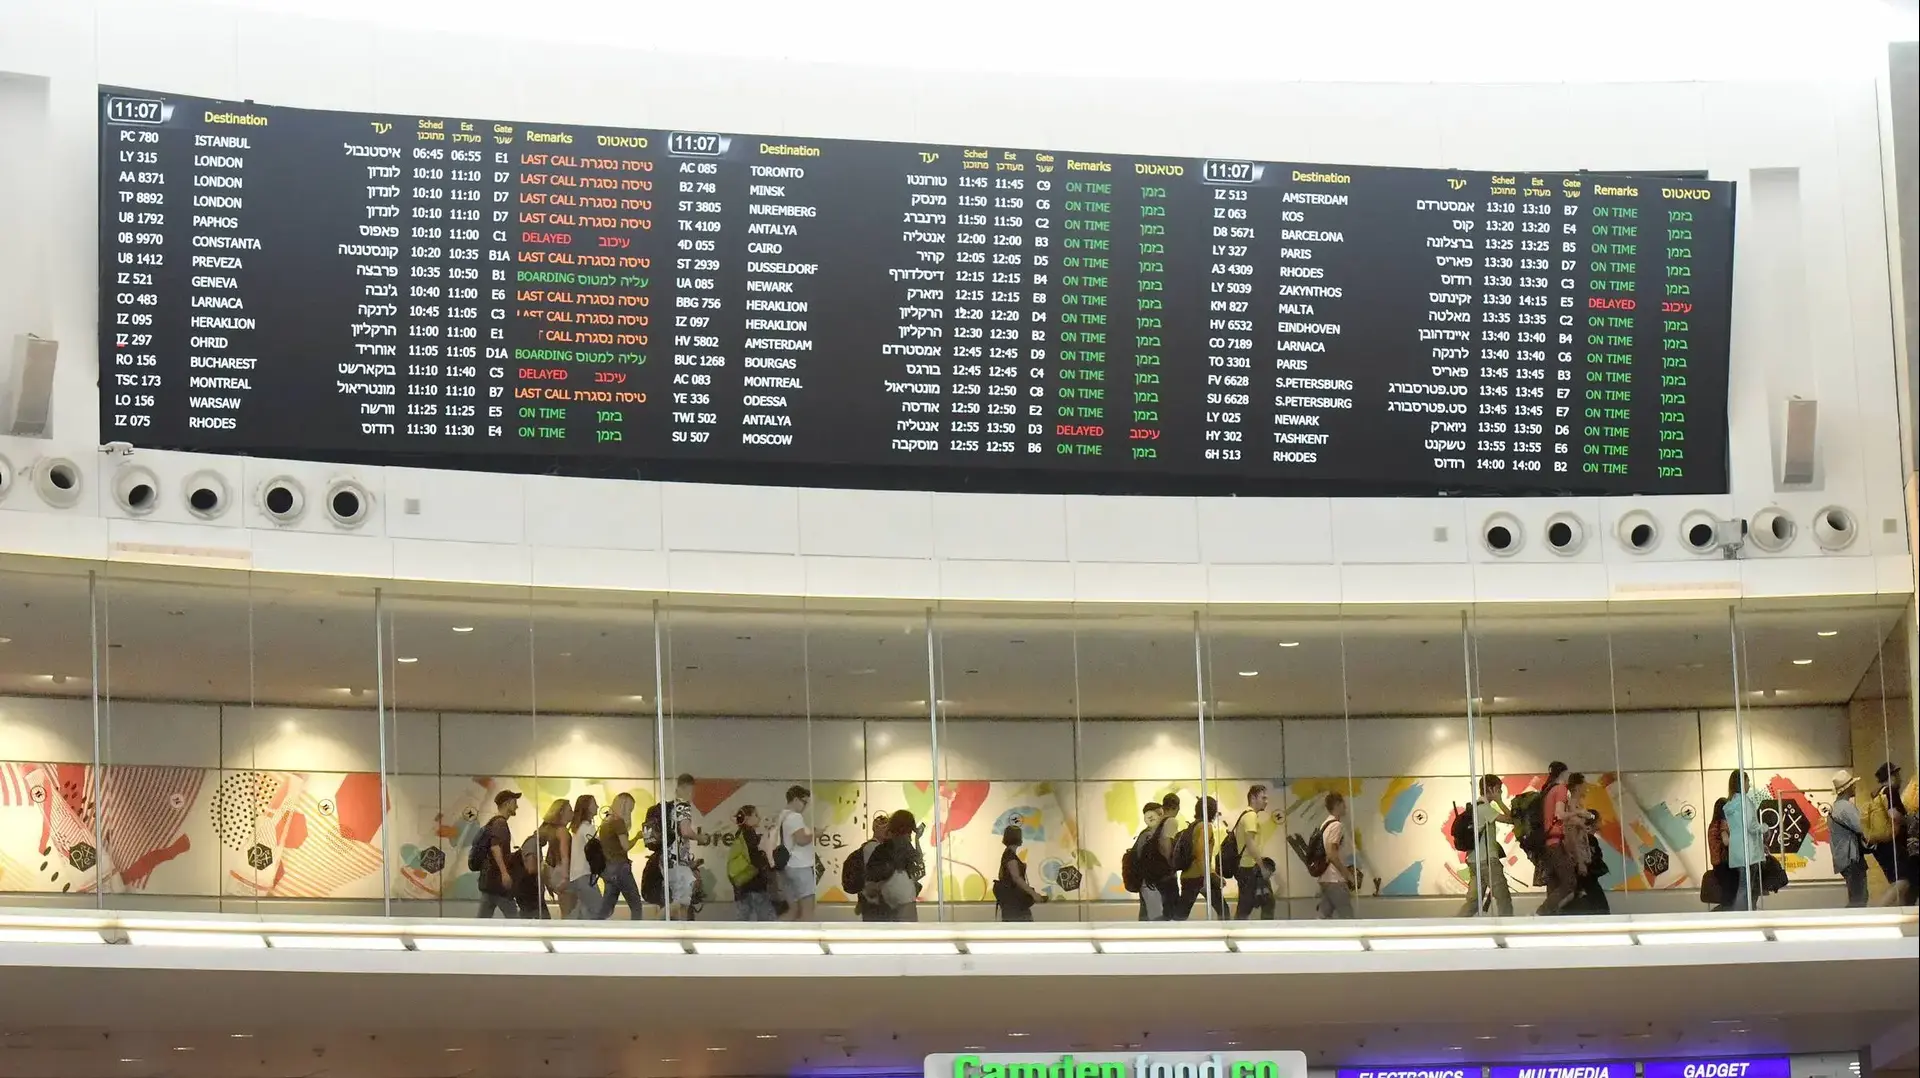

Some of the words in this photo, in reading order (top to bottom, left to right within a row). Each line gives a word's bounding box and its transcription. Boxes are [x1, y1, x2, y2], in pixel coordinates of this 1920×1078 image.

[115, 101, 158, 119] 11:07
[205, 111, 267, 126] Destination
[419, 120, 443, 129] Sched
[371, 122, 392, 134] יעד
[461, 123, 473, 131] Est
[494, 125, 512, 133] Gate
[120, 130, 136, 142] PC
[138, 131, 159, 143] 780
[195, 135, 251, 149] ISTANBUL
[494, 136, 512, 144] שער
[527, 131, 573, 143] Remarks
[597, 135, 647, 148] סטאטוס
[676, 136, 715, 150] 11:07
[344, 142, 401, 158] איסטנבול
[413, 148, 443, 160] 06:45
[760, 143, 820, 156] Destination
[964, 150, 987, 158] Sched
[194, 155, 243, 168] LONDON
[451, 150, 481, 162] 06:55
[495, 152, 508, 163] E1
[521, 154, 548, 165] LAST
[551, 156, 577, 166] CALL
[918, 152, 939, 163] יעד
[1004, 152, 1016, 160] Est
[1036, 154, 1054, 162] Gate
[580, 159, 618, 170] נסגרת
[622, 161, 653, 171] טיסה
[1036, 165, 1053, 173] שער
[1067, 160, 1111, 172] Remarks
[1135, 164, 1184, 176] סטאטוס
[750, 166, 804, 178] TORONTO
[1211, 164, 1249, 178] 11:07
[1293, 171, 1350, 183] Destination
[194, 175, 242, 188] LONDON
[1447, 179, 1466, 190] יעד
[1492, 176, 1515, 184] Sched
[1532, 178, 1543, 186] Est
[1563, 179, 1581, 187] Gate
[679, 181, 693, 192] B2
[696, 182, 716, 193] 748
[750, 185, 785, 196] MINSK
[1594, 185, 1638, 196] Remarks
[912, 194, 946, 206] מינסק
[1282, 193, 1348, 205] AMSTERDAM
[1563, 190, 1580, 198] שער
[1662, 188, 1710, 200] סטאטוס
[193, 195, 242, 209] LONDON
[959, 195, 987, 207] 11:50
[995, 197, 1023, 208] 11:50
[1036, 199, 1050, 210] C6
[1065, 201, 1081, 210] ON
[1085, 202, 1110, 212] TIME
[749, 204, 816, 217] NUREMBERG
[1141, 206, 1165, 217] בזמן
[1214, 208, 1225, 218] IZ
[1228, 209, 1247, 219] 063
[1282, 211, 1304, 222] KOS
[193, 215, 238, 228] PAPHOS
[1452, 220, 1474, 233] קוס
[1486, 220, 1514, 231] 13:20
[1522, 222, 1550, 233] 13:20
[748, 223, 797, 235] ANTALYA
[1563, 224, 1577, 234] E4
[1592, 225, 1608, 235] ON
[1612, 226, 1637, 236] TIME
[1667, 230, 1692, 240] בזמן
[1281, 229, 1344, 242] BARCELONA
[192, 236, 261, 250] CONSTANTA
[748, 242, 782, 254] CAIRO
[118, 252, 133, 264] U8
[137, 253, 163, 265] 1412
[1281, 248, 1312, 259] PARIS
[192, 256, 242, 269] PREVEZA
[747, 261, 818, 274] DUSSELDORF
[357, 265, 398, 277] פרבצה
[411, 266, 440, 278] 10:35
[449, 268, 478, 279] 10:50
[492, 269, 506, 281] B1
[517, 271, 574, 283] BOARDING
[1280, 266, 1324, 278] RHODES
[192, 276, 238, 288] GENEVA
[578, 274, 616, 285] למטוס
[621, 275, 648, 288] עליה
[747, 281, 793, 293] NEWARK
[1211, 282, 1224, 292] LY
[1227, 283, 1252, 294] 5039
[1279, 285, 1342, 298] ZAKYNTHOS
[191, 296, 243, 309] LARNACA
[1429, 292, 1472, 306] זקינתוס
[1483, 294, 1512, 305] 13:30
[1519, 295, 1547, 306] 14:15
[1560, 297, 1573, 307] E5
[1589, 298, 1636, 309] DELAYED
[746, 300, 808, 312] HERAKLION
[1279, 303, 1314, 315] MALTA
[1662, 302, 1692, 313] עיכוב
[191, 316, 255, 329] HERAKLION
[746, 319, 807, 331] HERAKLION
[1278, 322, 1340, 334] EINDHOVEN
[190, 336, 228, 348] OHRID
[745, 338, 812, 350] AMSTERDAM
[1277, 340, 1325, 352] LARNACA
[190, 356, 257, 369] BUCHAREST
[745, 357, 796, 369] BOURGAS
[1277, 359, 1307, 370] PARIS
[190, 376, 252, 389] MONTREAL
[744, 376, 803, 388] MONTREAL
[1276, 377, 1353, 390] S.PETERSBURG
[189, 396, 241, 409] WARSAW
[743, 395, 787, 407] ODESSA
[1275, 396, 1352, 409] S.PETERSBURG
[189, 417, 236, 429] RHODES
[672, 412, 695, 423] TWI
[697, 413, 717, 424] 502
[742, 414, 792, 426] ANTALYA
[1275, 414, 1320, 426] NEWARK
[897, 418, 939, 432] אנטליה
[951, 421, 979, 432] 12:55
[987, 423, 1016, 433] 13:50
[1028, 424, 1042, 434] D3
[1056, 425, 1104, 436] DELAYED
[743, 433, 793, 445] MOSCOW
[1129, 429, 1160, 440] עיכוב
[1273, 433, 1329, 444] TASHKENT
[1205, 449, 1219, 459] 6H
[1222, 449, 1241, 460] 513
[1273, 451, 1317, 463] RHODES
[1434, 458, 1465, 469] רודוס
[1477, 459, 1505, 470] 14:00
[1513, 460, 1541, 471] 14:00
[1554, 461, 1567, 472] B2
[1583, 463, 1598, 473] ON
[1602, 464, 1628, 474] TIME
[1658, 467, 1683, 478] בזמן
[953, 1054, 1126, 1078] Camden
[1134, 1053, 1222, 1078] food
[1684, 1062, 1750, 1078] GADGET
